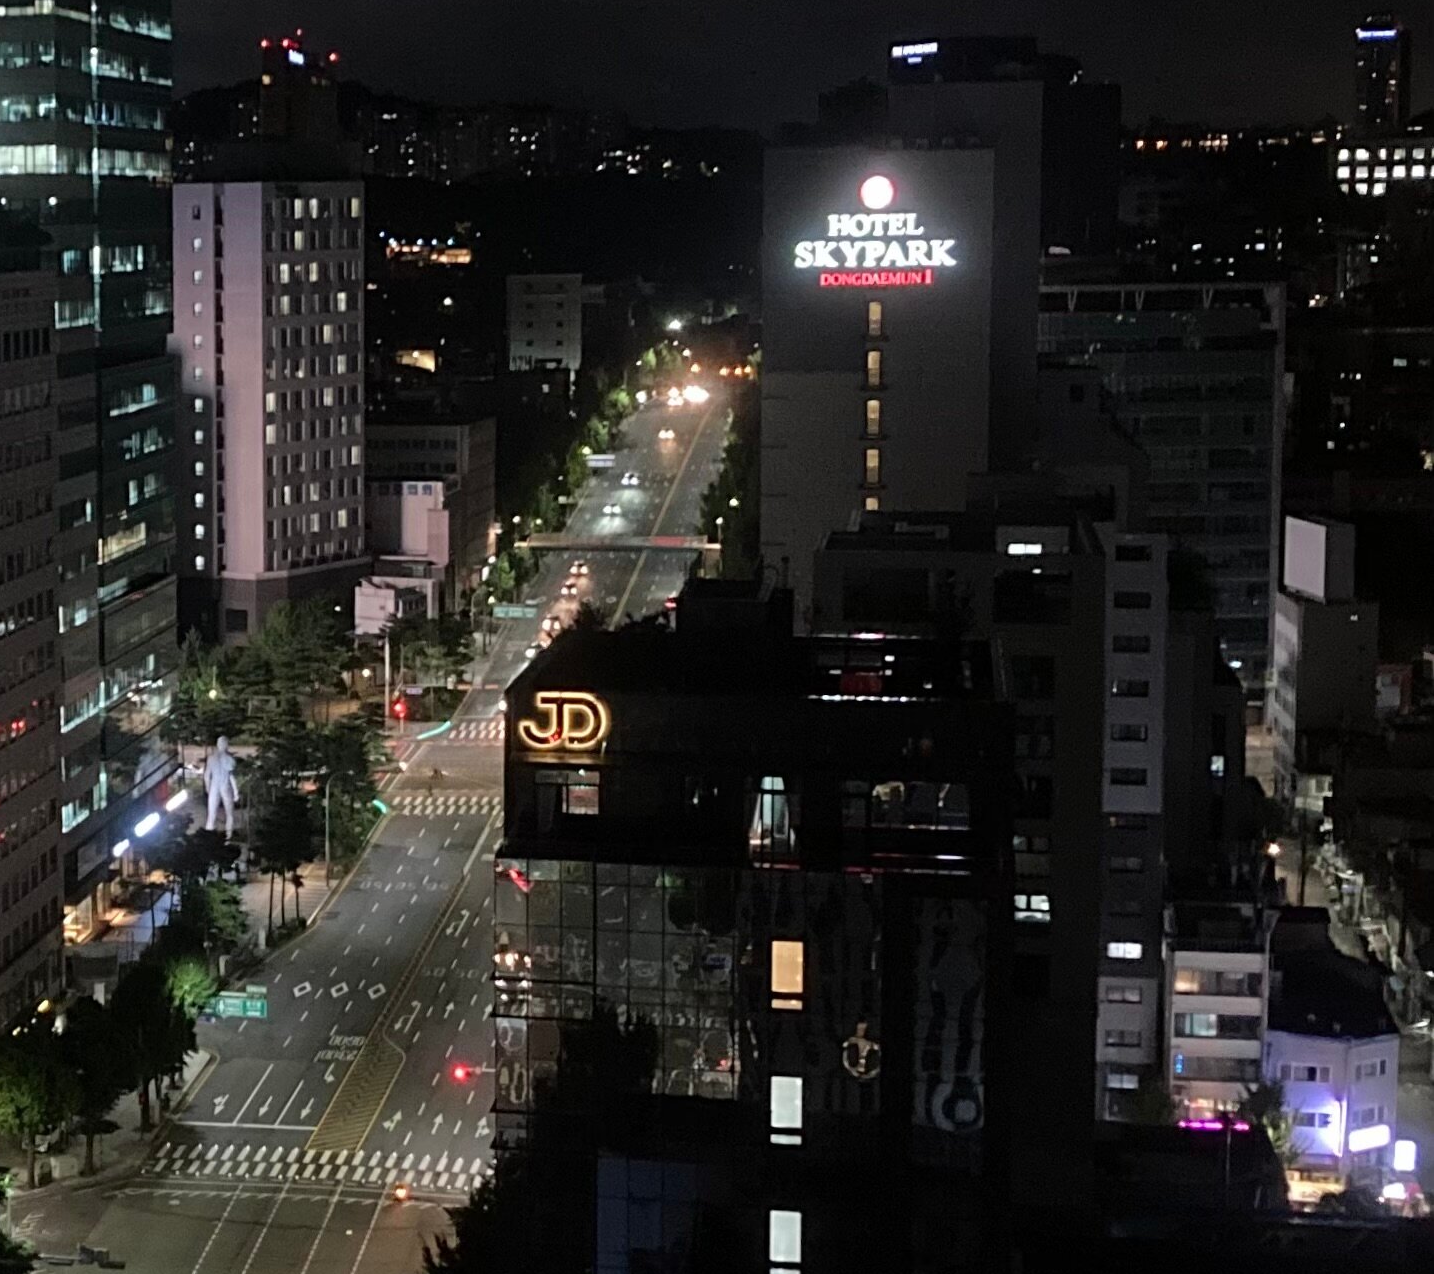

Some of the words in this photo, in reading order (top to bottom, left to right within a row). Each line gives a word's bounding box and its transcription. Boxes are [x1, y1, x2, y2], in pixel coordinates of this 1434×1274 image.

[827, 212, 924, 237] HOTEL
[794, 239, 957, 269] SKYPARK
[820, 271, 922, 287] DONGDAEMUN
[517, 690, 609, 750] JD
